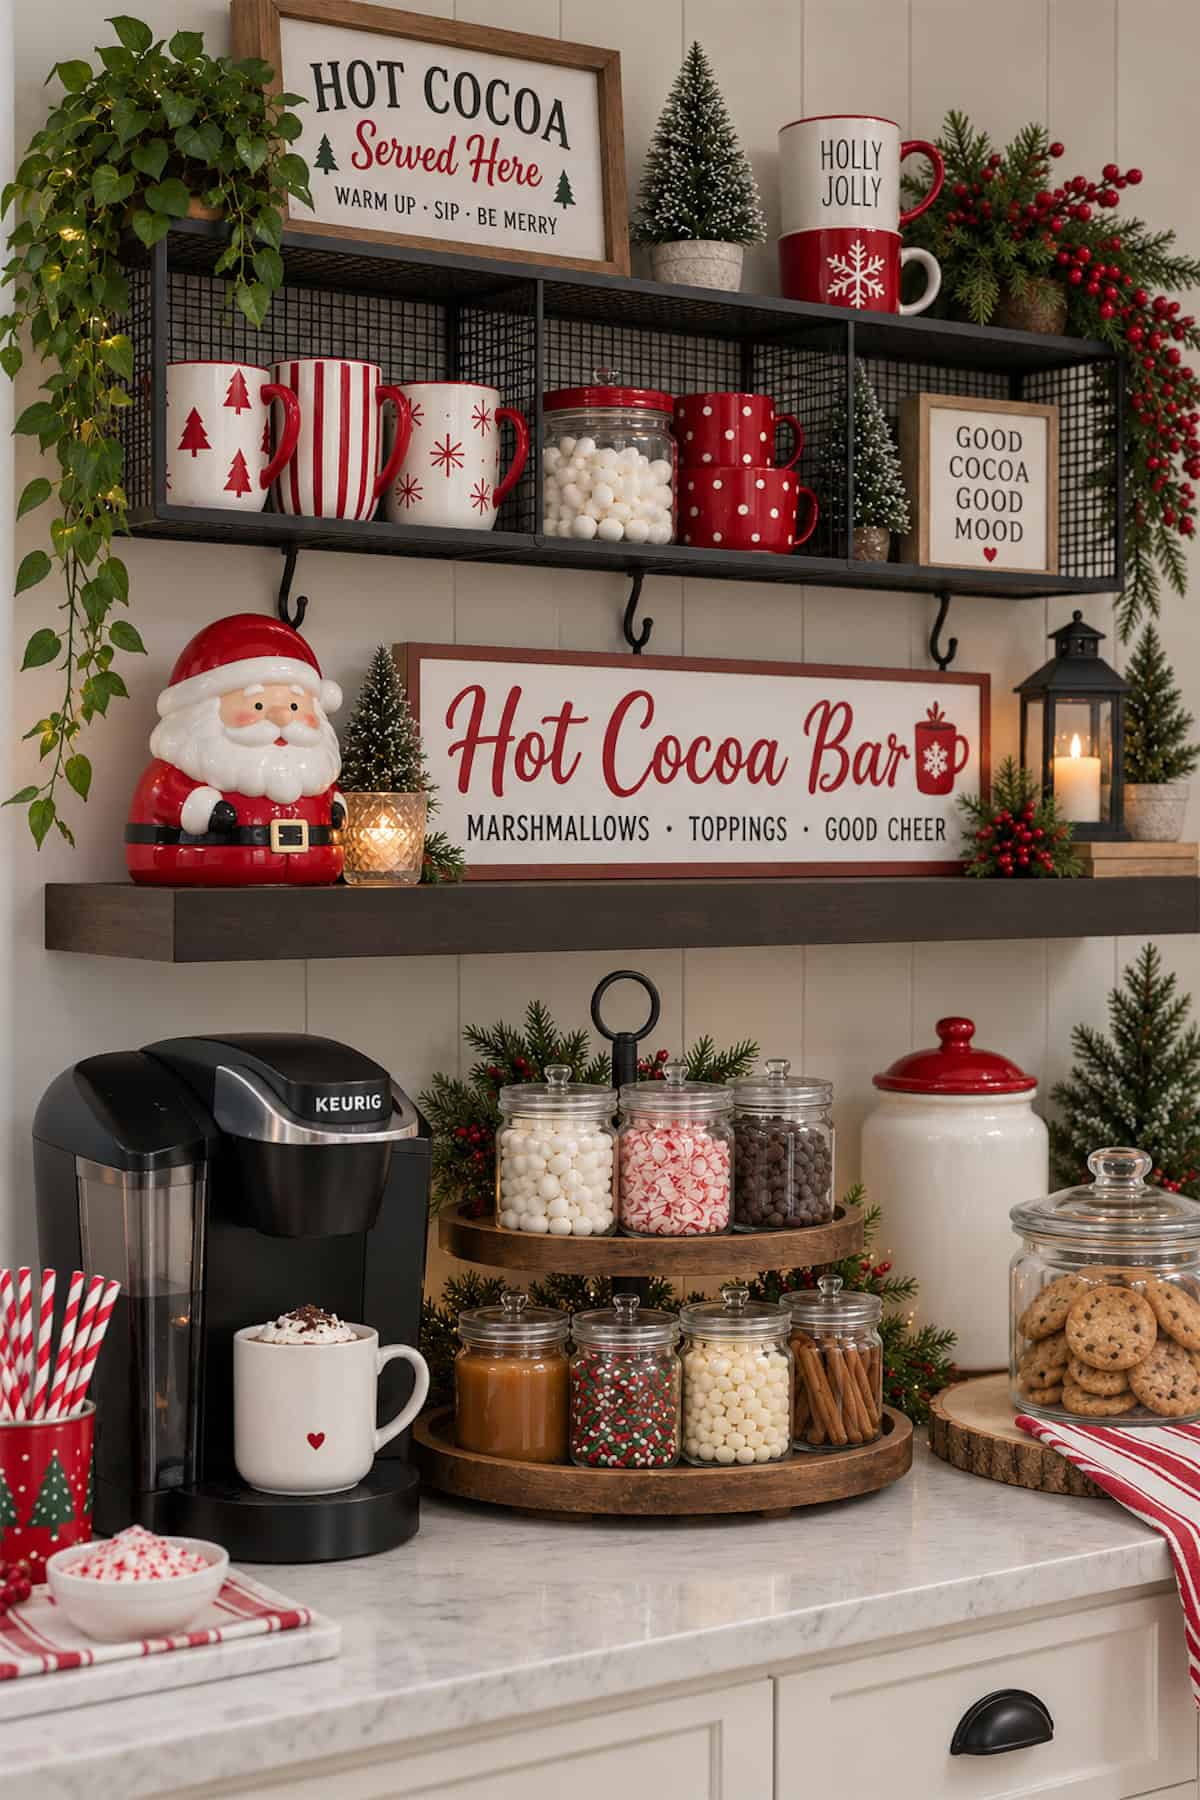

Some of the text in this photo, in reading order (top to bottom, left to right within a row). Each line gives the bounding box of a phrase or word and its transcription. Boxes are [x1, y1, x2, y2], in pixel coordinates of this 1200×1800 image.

[310, 60, 571, 150] HOT COCOA
[352, 119, 543, 186] Served Here
[821, 139, 882, 170] HOLLY
[822, 176, 881, 207] JOLLY
[335, 186, 557, 235] WARM UP SIP BE MERRY
[957, 426, 1022, 452] GOOD
[950, 456, 1029, 483] COCOA
[957, 487, 1022, 512] GOOD
[956, 517, 1023, 542] MOOD
[446, 685, 909, 797] Hot Cocoa Bar
[467, 815, 946, 841] MARSHMALLOWS TOPPINGS GOOD CHEER
[316, 1095, 381, 1112] KEURIG
